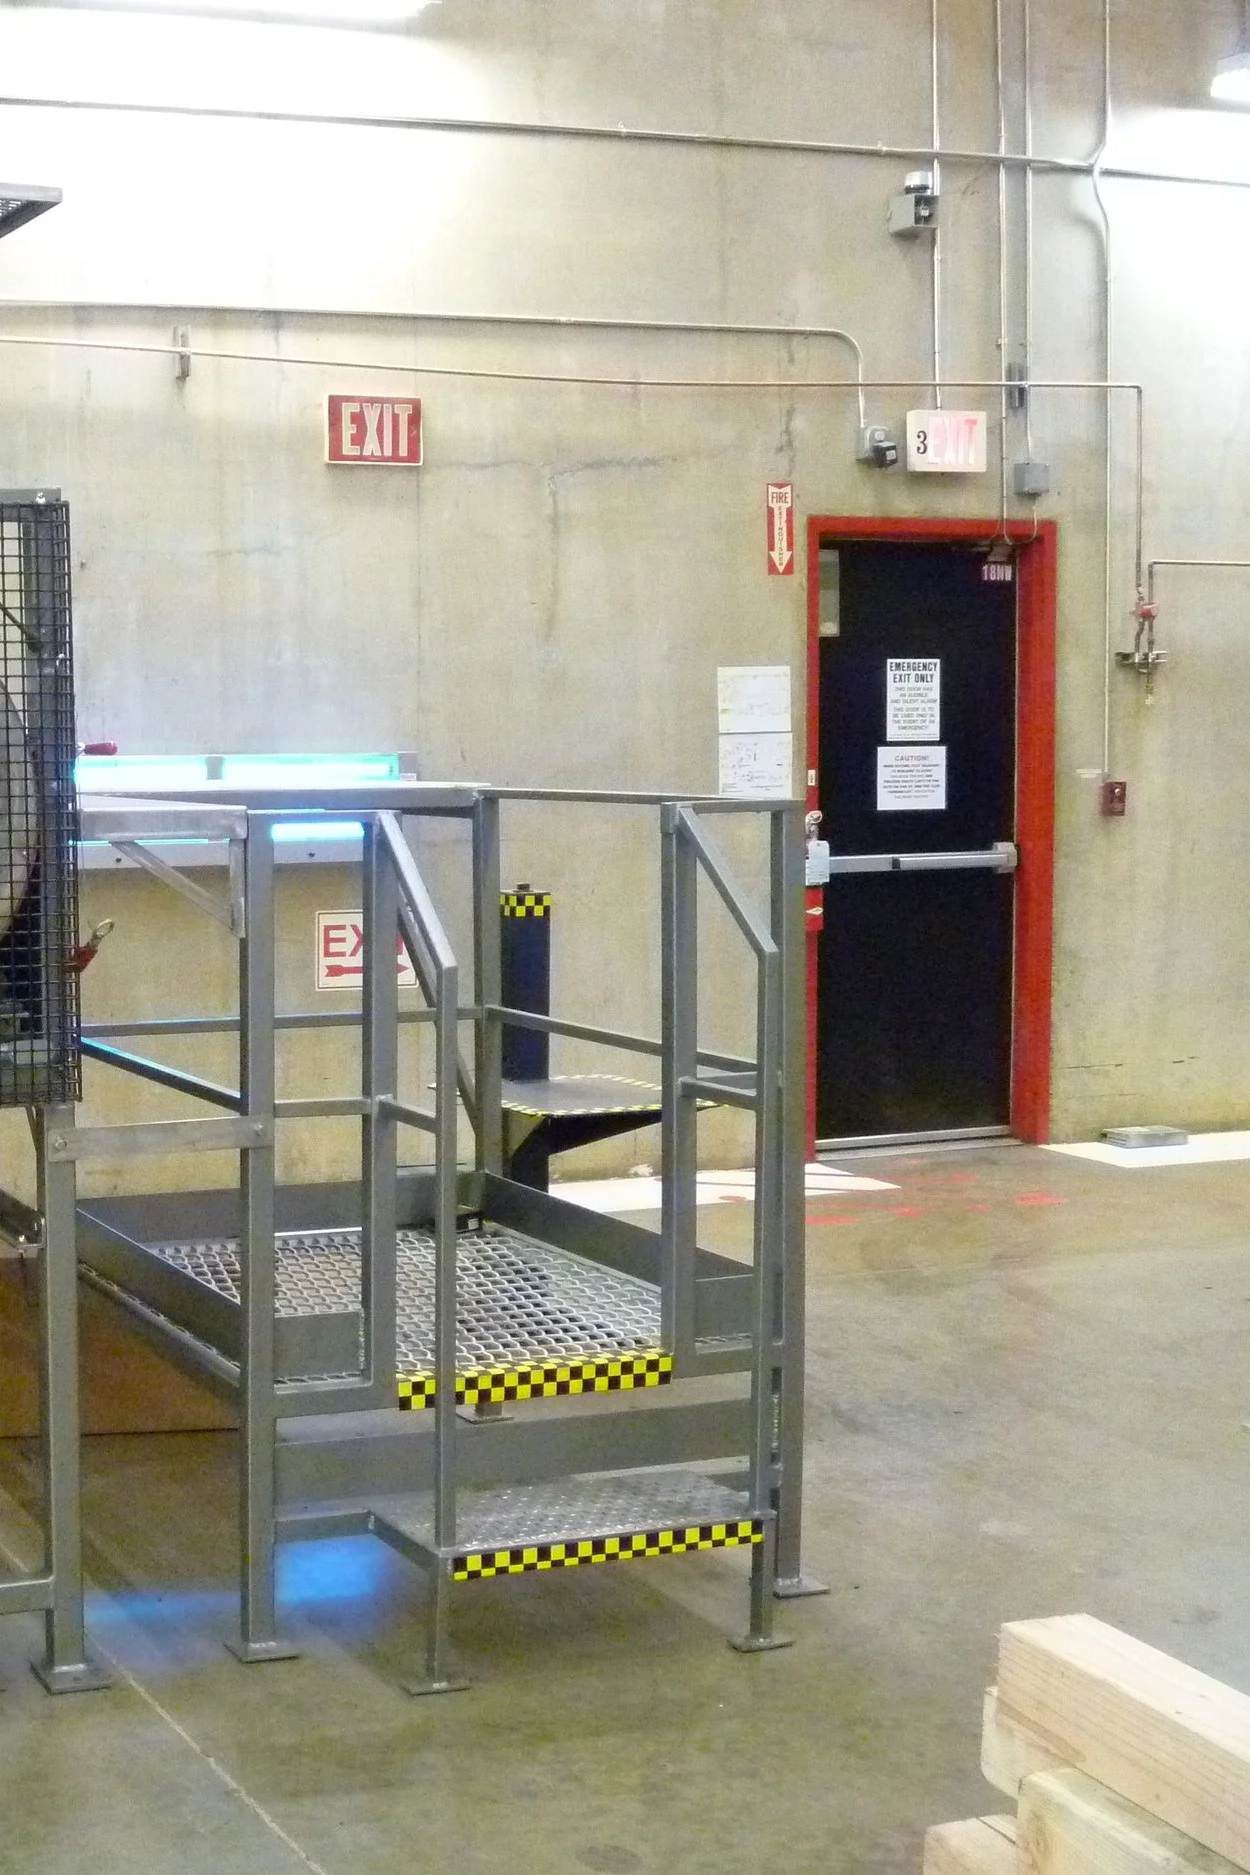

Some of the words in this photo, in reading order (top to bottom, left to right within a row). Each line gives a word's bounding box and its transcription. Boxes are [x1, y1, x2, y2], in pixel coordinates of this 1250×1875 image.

[342, 402, 412, 457] EXIT
[916, 430, 928, 455] 3
[928, 417, 978, 464] EXIT
[771, 491, 789, 504] FIRE
[982, 564, 1012, 581] 18NW
[889, 661, 938, 672] EMERGENCY
[893, 673, 911, 683] EXIT
[914, 673, 934, 683] ONLY
